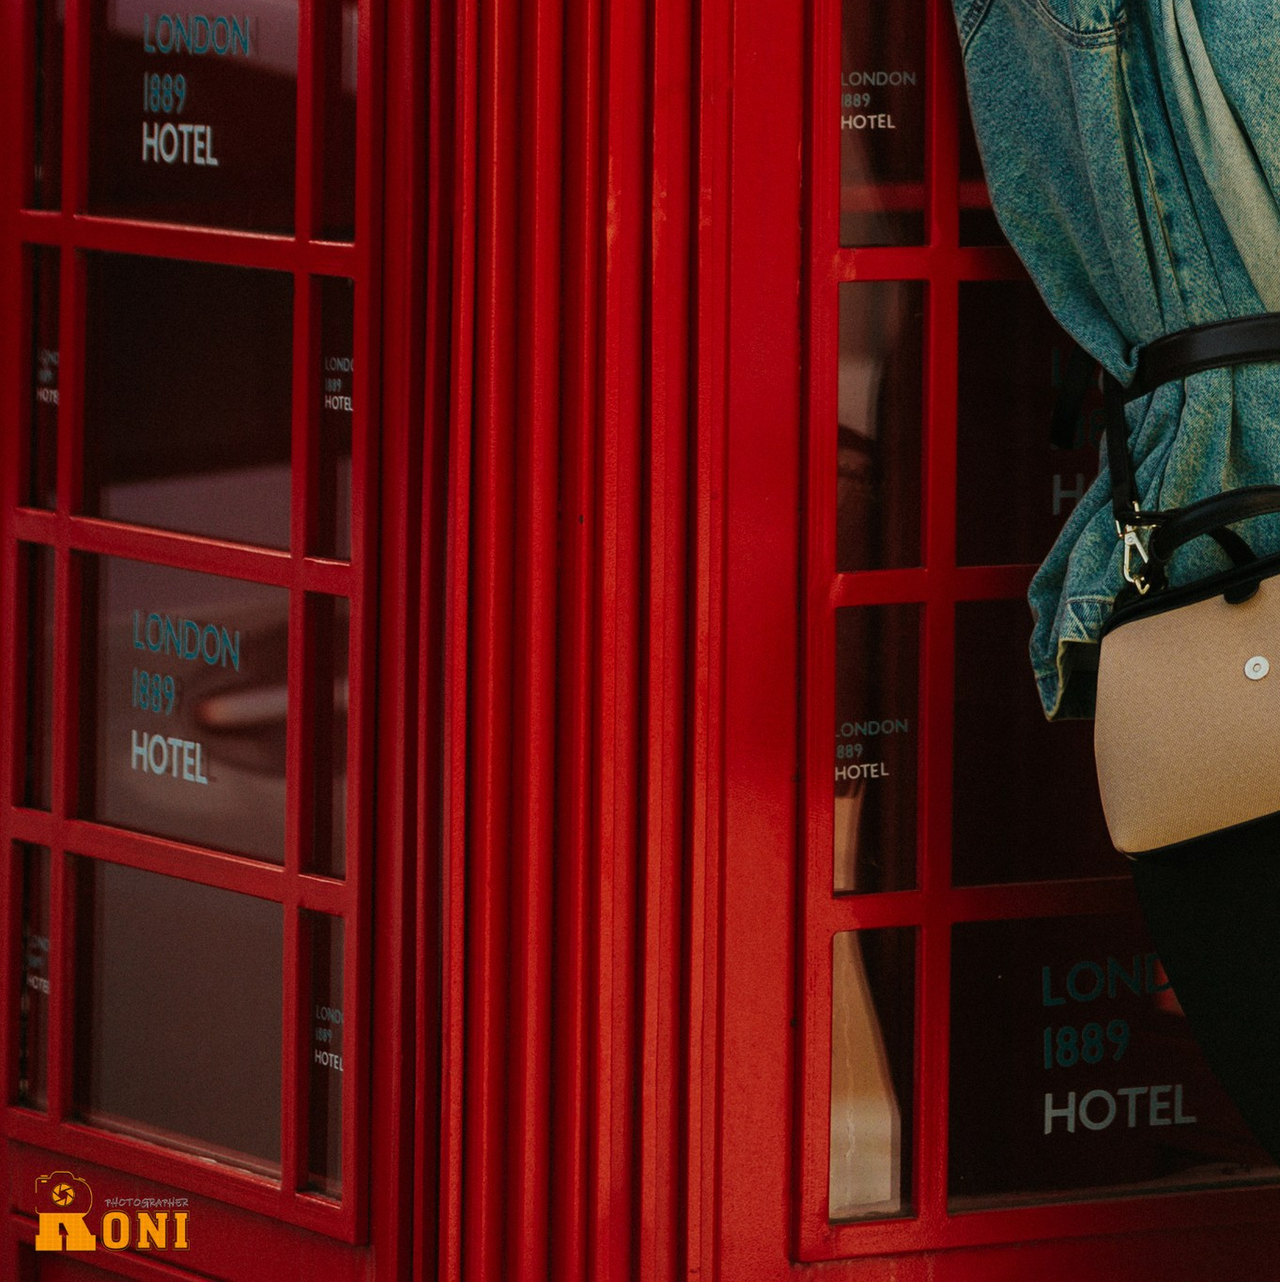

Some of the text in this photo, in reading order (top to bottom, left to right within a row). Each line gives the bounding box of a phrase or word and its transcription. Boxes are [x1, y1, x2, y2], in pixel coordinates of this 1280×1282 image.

[143, 13, 250, 55] LONDON
[143, 71, 187, 113] 1889
[841, 71, 916, 86] LONDON
[841, 113, 896, 130] HOTEL
[142, 121, 219, 166] HOTEL
[324, 395, 353, 412] HOTEL
[133, 609, 241, 672] LONDON
[132, 667, 176, 716] 1889
[836, 719, 909, 738] ONDON
[131, 729, 208, 785] HOTEL
[835, 762, 890, 781] HOTEL
[836, 743, 863, 759] 889
[1042, 952, 1172, 1006] LOND
[316, 1005, 343, 1024] LOND
[1043, 1019, 1130, 1069] 1889
[1044, 1084, 1197, 1135] HOTEL
